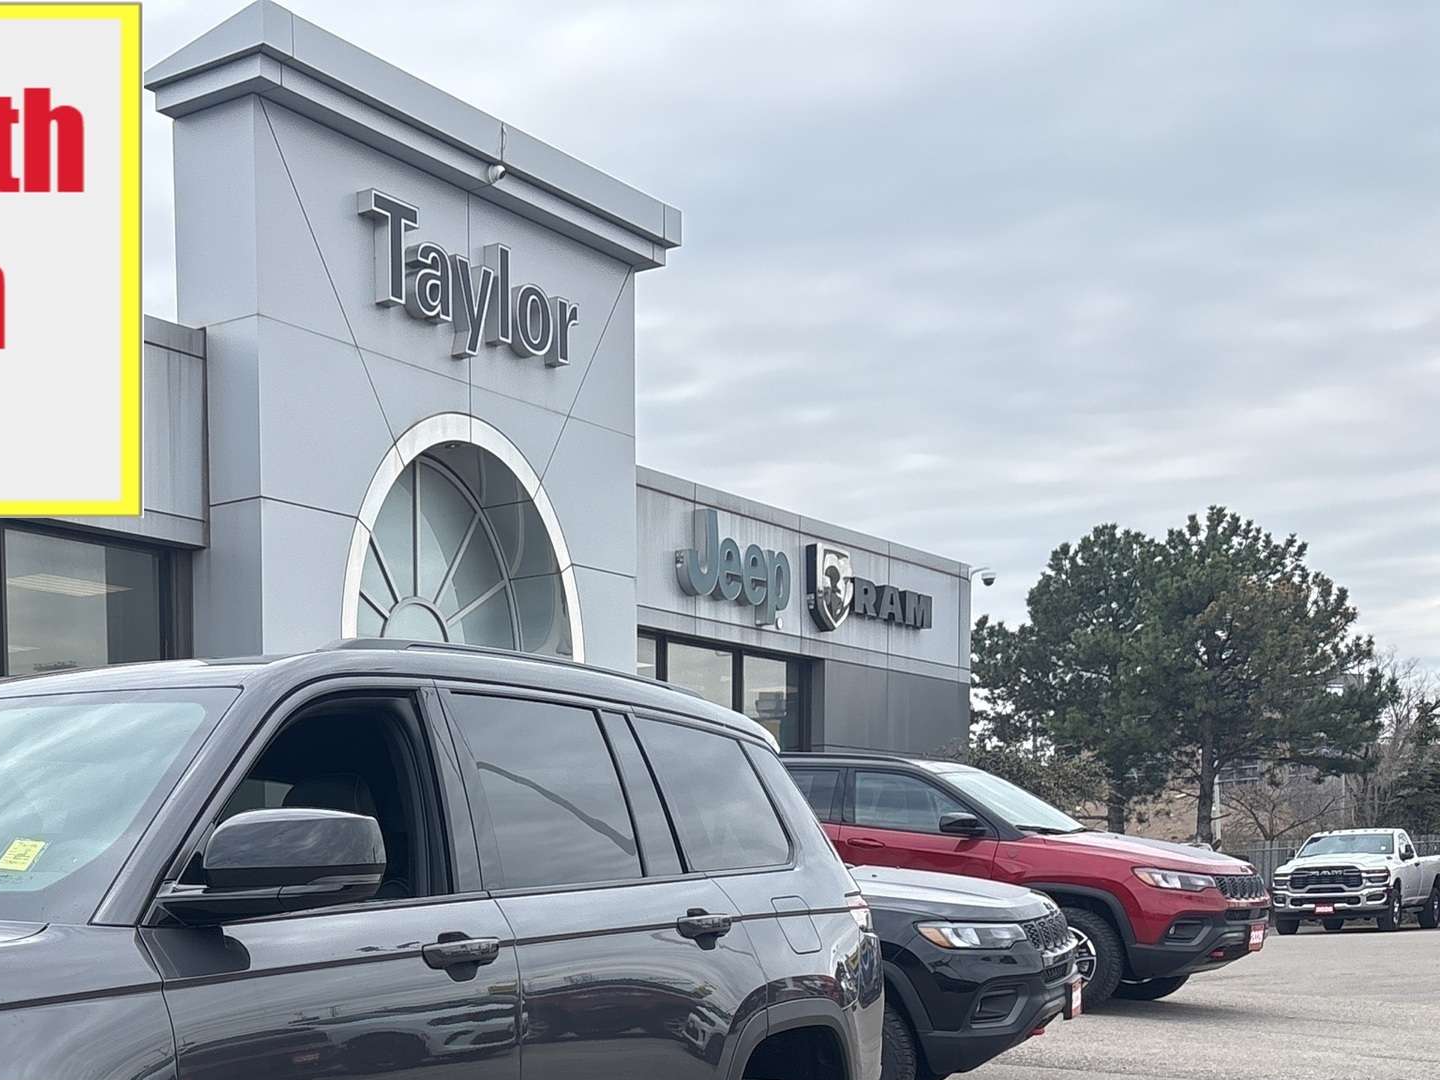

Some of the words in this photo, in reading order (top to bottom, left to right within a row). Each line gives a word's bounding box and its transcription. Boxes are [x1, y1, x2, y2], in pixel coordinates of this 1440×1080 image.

[357, 187, 579, 367] Taylor
[675, 508, 791, 625] Jeep
[851, 577, 932, 629] RAM
